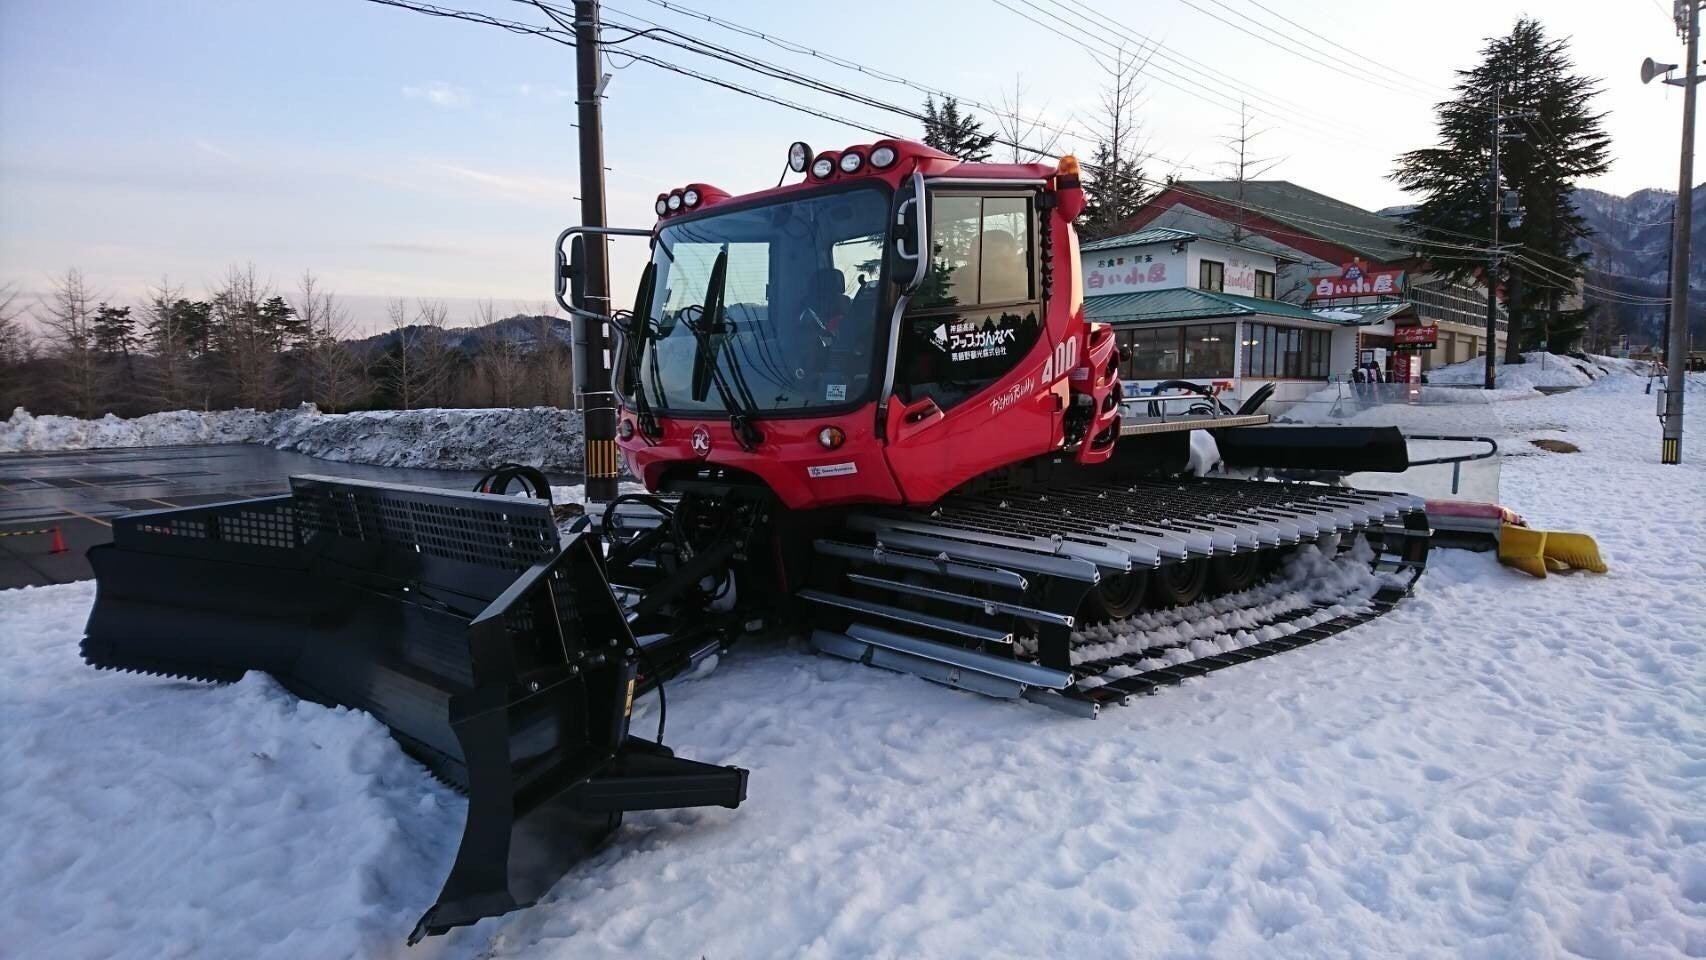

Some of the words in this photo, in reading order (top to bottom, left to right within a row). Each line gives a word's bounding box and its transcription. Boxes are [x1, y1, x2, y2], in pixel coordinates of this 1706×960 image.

[1087, 262, 1167, 289] 白い小屋
[1316, 274, 1393, 296] 白い小屋
[950, 328, 1016, 350] アップかんなべ
[1042, 335, 1077, 385] 400
